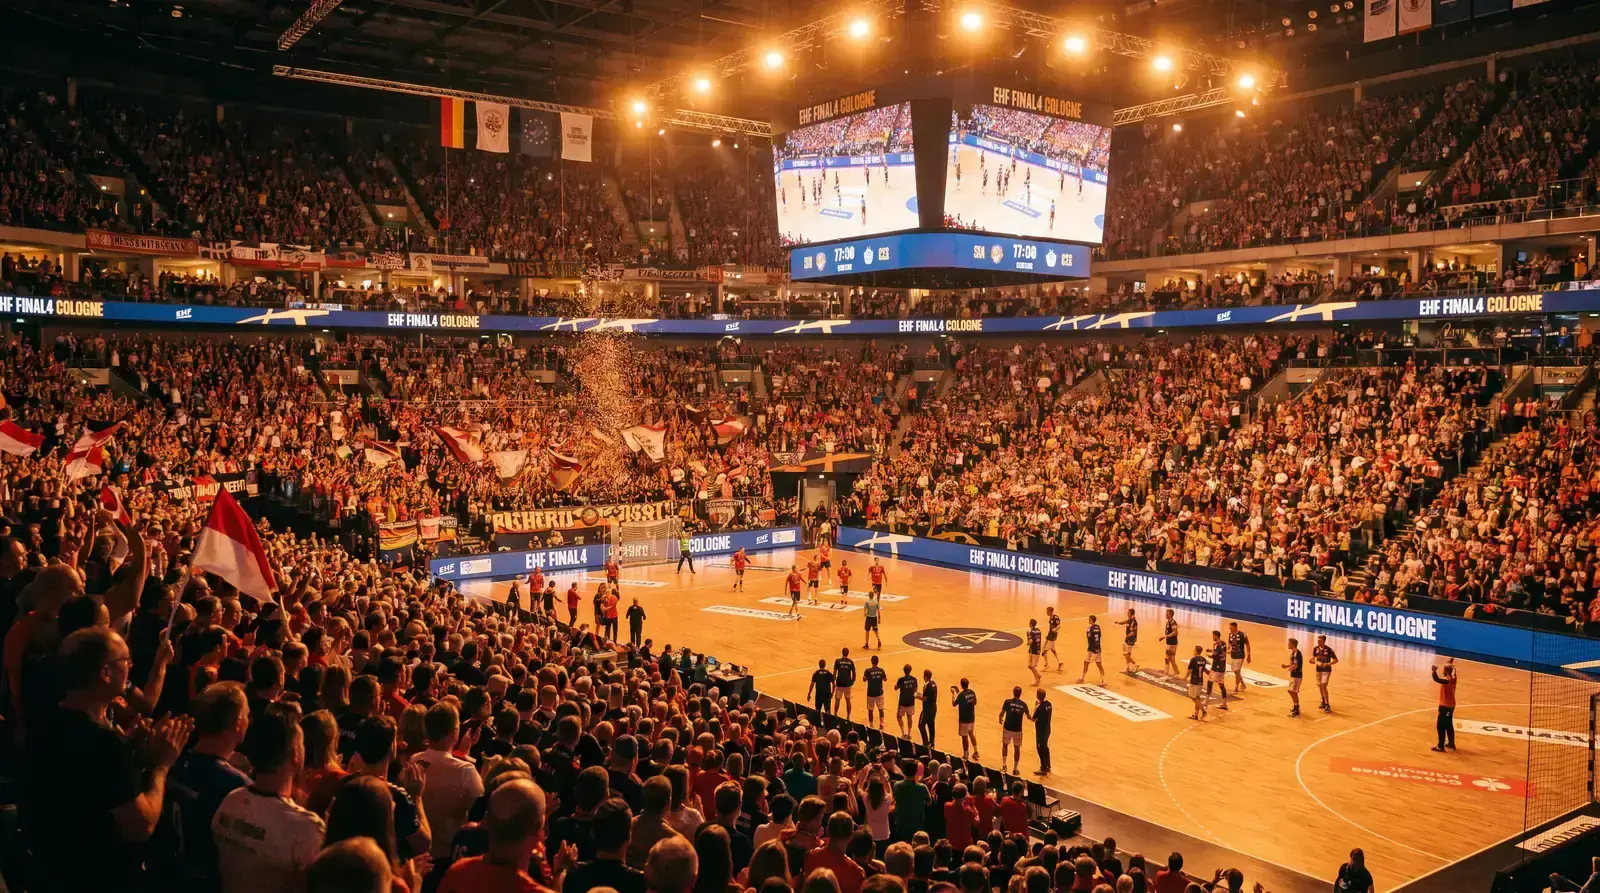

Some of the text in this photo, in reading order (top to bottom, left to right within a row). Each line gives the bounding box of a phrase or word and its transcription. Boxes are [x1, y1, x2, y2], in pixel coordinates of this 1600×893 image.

[800, 90, 876, 124] EHF FINAL4 COLOGNE
[993, 86, 1082, 118] EHF FINAL4 COLOGNE
[16, 298, 54, 314] FINAL4
[56, 300, 104, 316] COLOGNE
[176, 308, 192, 319] EHF
[1420, 295, 1542, 316] EHF FINAL4 COLOGNE
[388, 314, 480, 328] EHF FINAL4 COLOGNE
[899, 320, 982, 332] EHF FINAL4 COLOGNE
[688, 536, 730, 552] COLOGNE
[439, 564, 454, 575] EHF
[526, 552, 546, 570] EHF
[970, 550, 1058, 578] EHF FINAL4 COLOGNE
[1108, 570, 1222, 605] EHF FINAL4 COLOGNE
[1288, 598, 1436, 641] EHF FINAL4 COLOGNE
